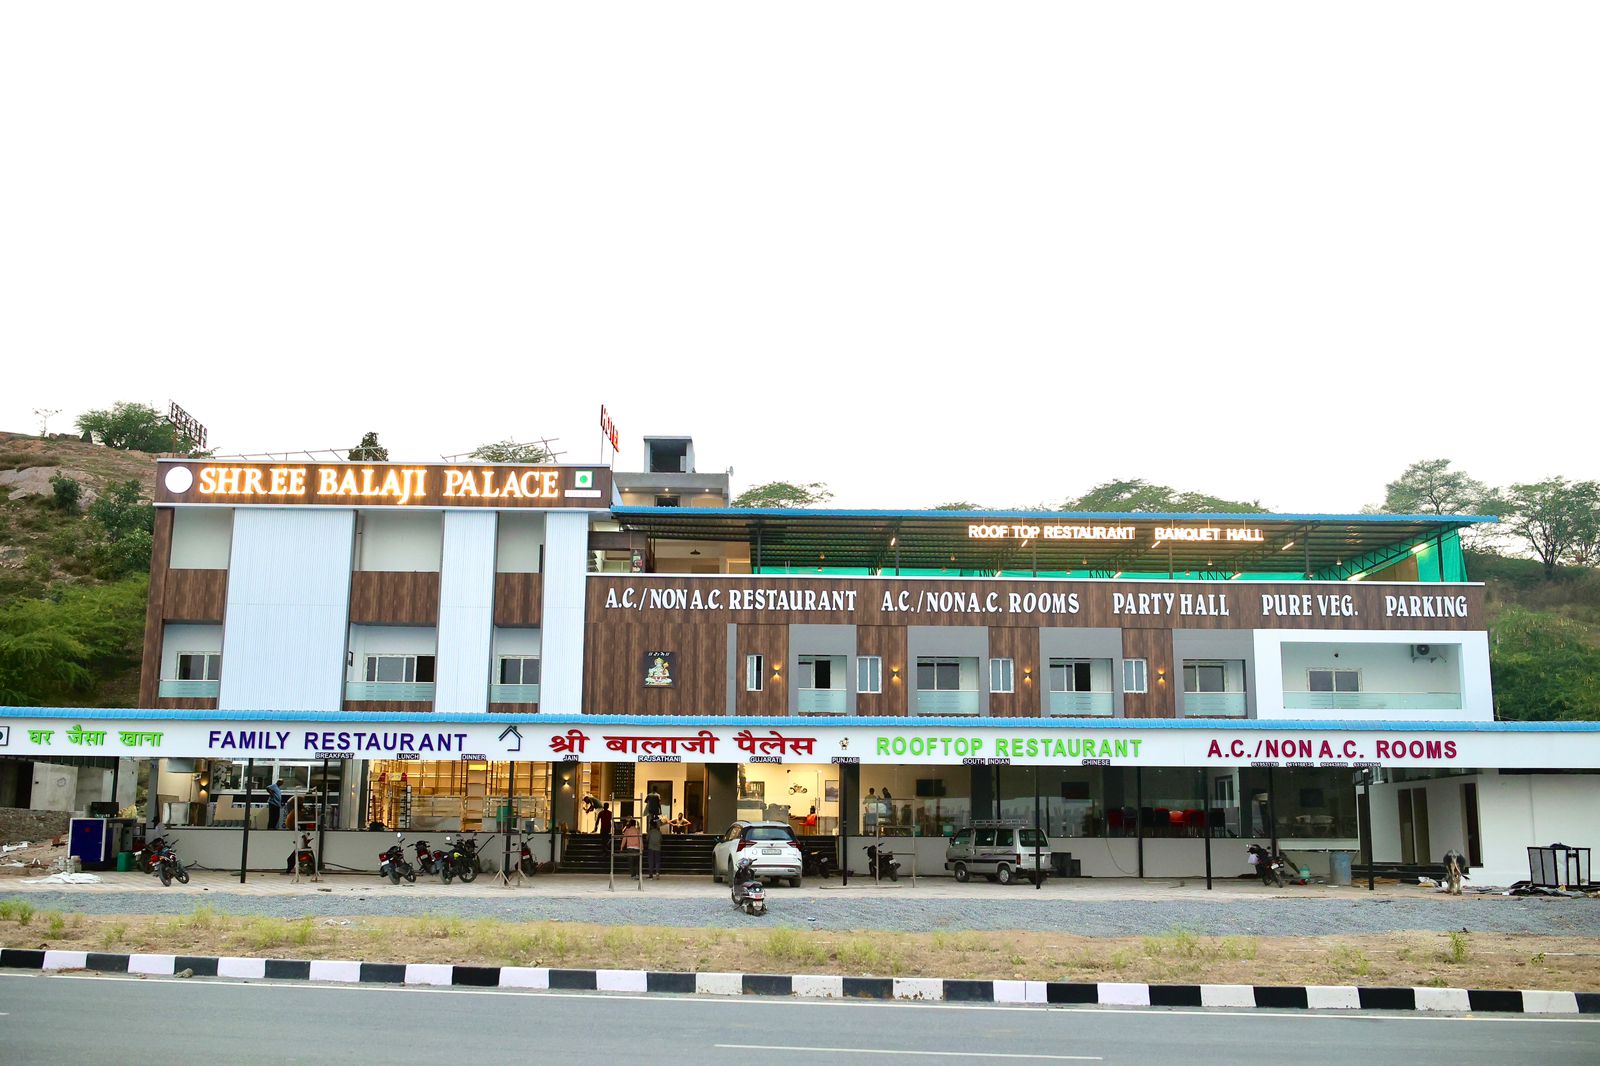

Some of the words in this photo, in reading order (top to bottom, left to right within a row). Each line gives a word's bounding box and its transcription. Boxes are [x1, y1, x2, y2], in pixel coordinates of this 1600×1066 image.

[198, 466, 307, 496] SHREE
[316, 468, 429, 505] BALAJI
[442, 469, 560, 499] PALACE
[967, 524, 1009, 539] ROOF
[1011, 525, 1040, 539] TOP
[1043, 525, 1136, 541] RESTAURANT
[1153, 527, 1221, 541] BANQUET
[1226, 528, 1265, 542] HALL
[728, 589, 857, 611] RESTAURANT
[1008, 592, 1080, 614] ROOMS
[1112, 592, 1175, 615] PARTY
[1179, 593, 1230, 616] HALL
[1261, 594, 1313, 616] PURE
[1316, 594, 1360, 617] VEG.
[1384, 595, 1469, 618] PARKING
[28, 729, 54, 746] घर
[66, 725, 107, 746] जैसा
[119, 731, 163, 747] खाना
[208, 731, 290, 750] FAMILY
[304, 731, 468, 752] RESTAURANT
[548, 729, 590, 754] श्री
[603, 730, 721, 754] बालाजी
[733, 730, 818, 755] पैलेस
[877, 735, 984, 757] ROOFTOP
[995, 737, 1144, 759] RESTAURANT
[1376, 740, 1457, 759] ROOMS
